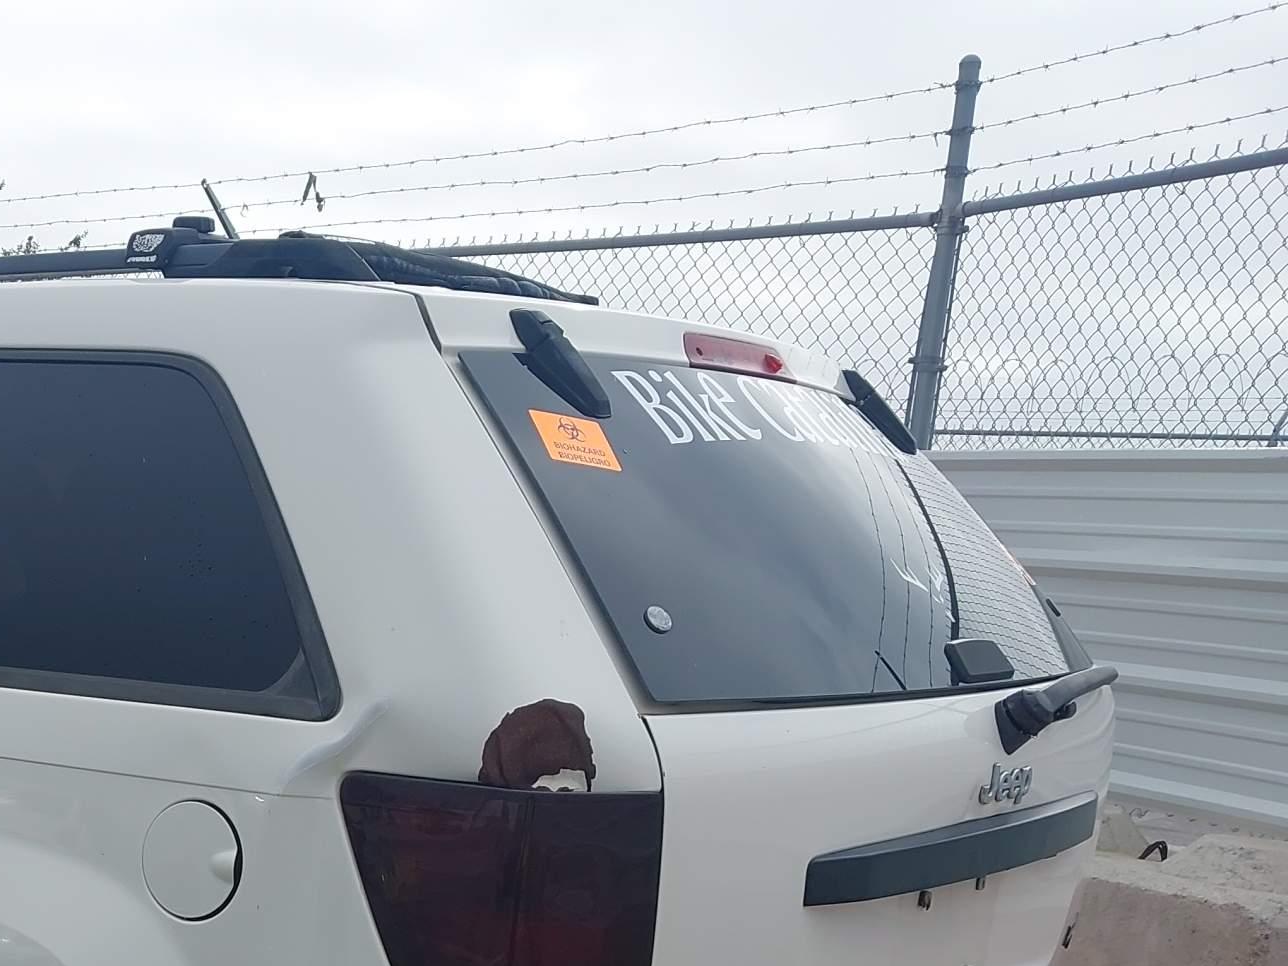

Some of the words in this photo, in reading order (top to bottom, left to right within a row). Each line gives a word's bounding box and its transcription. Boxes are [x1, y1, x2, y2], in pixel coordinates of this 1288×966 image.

[611, 370, 762, 444] Bike
[553, 441, 606, 457] BIOHAZARD
[558, 451, 611, 467] BIOPELIGRO
[978, 762, 1032, 805] Jeep
